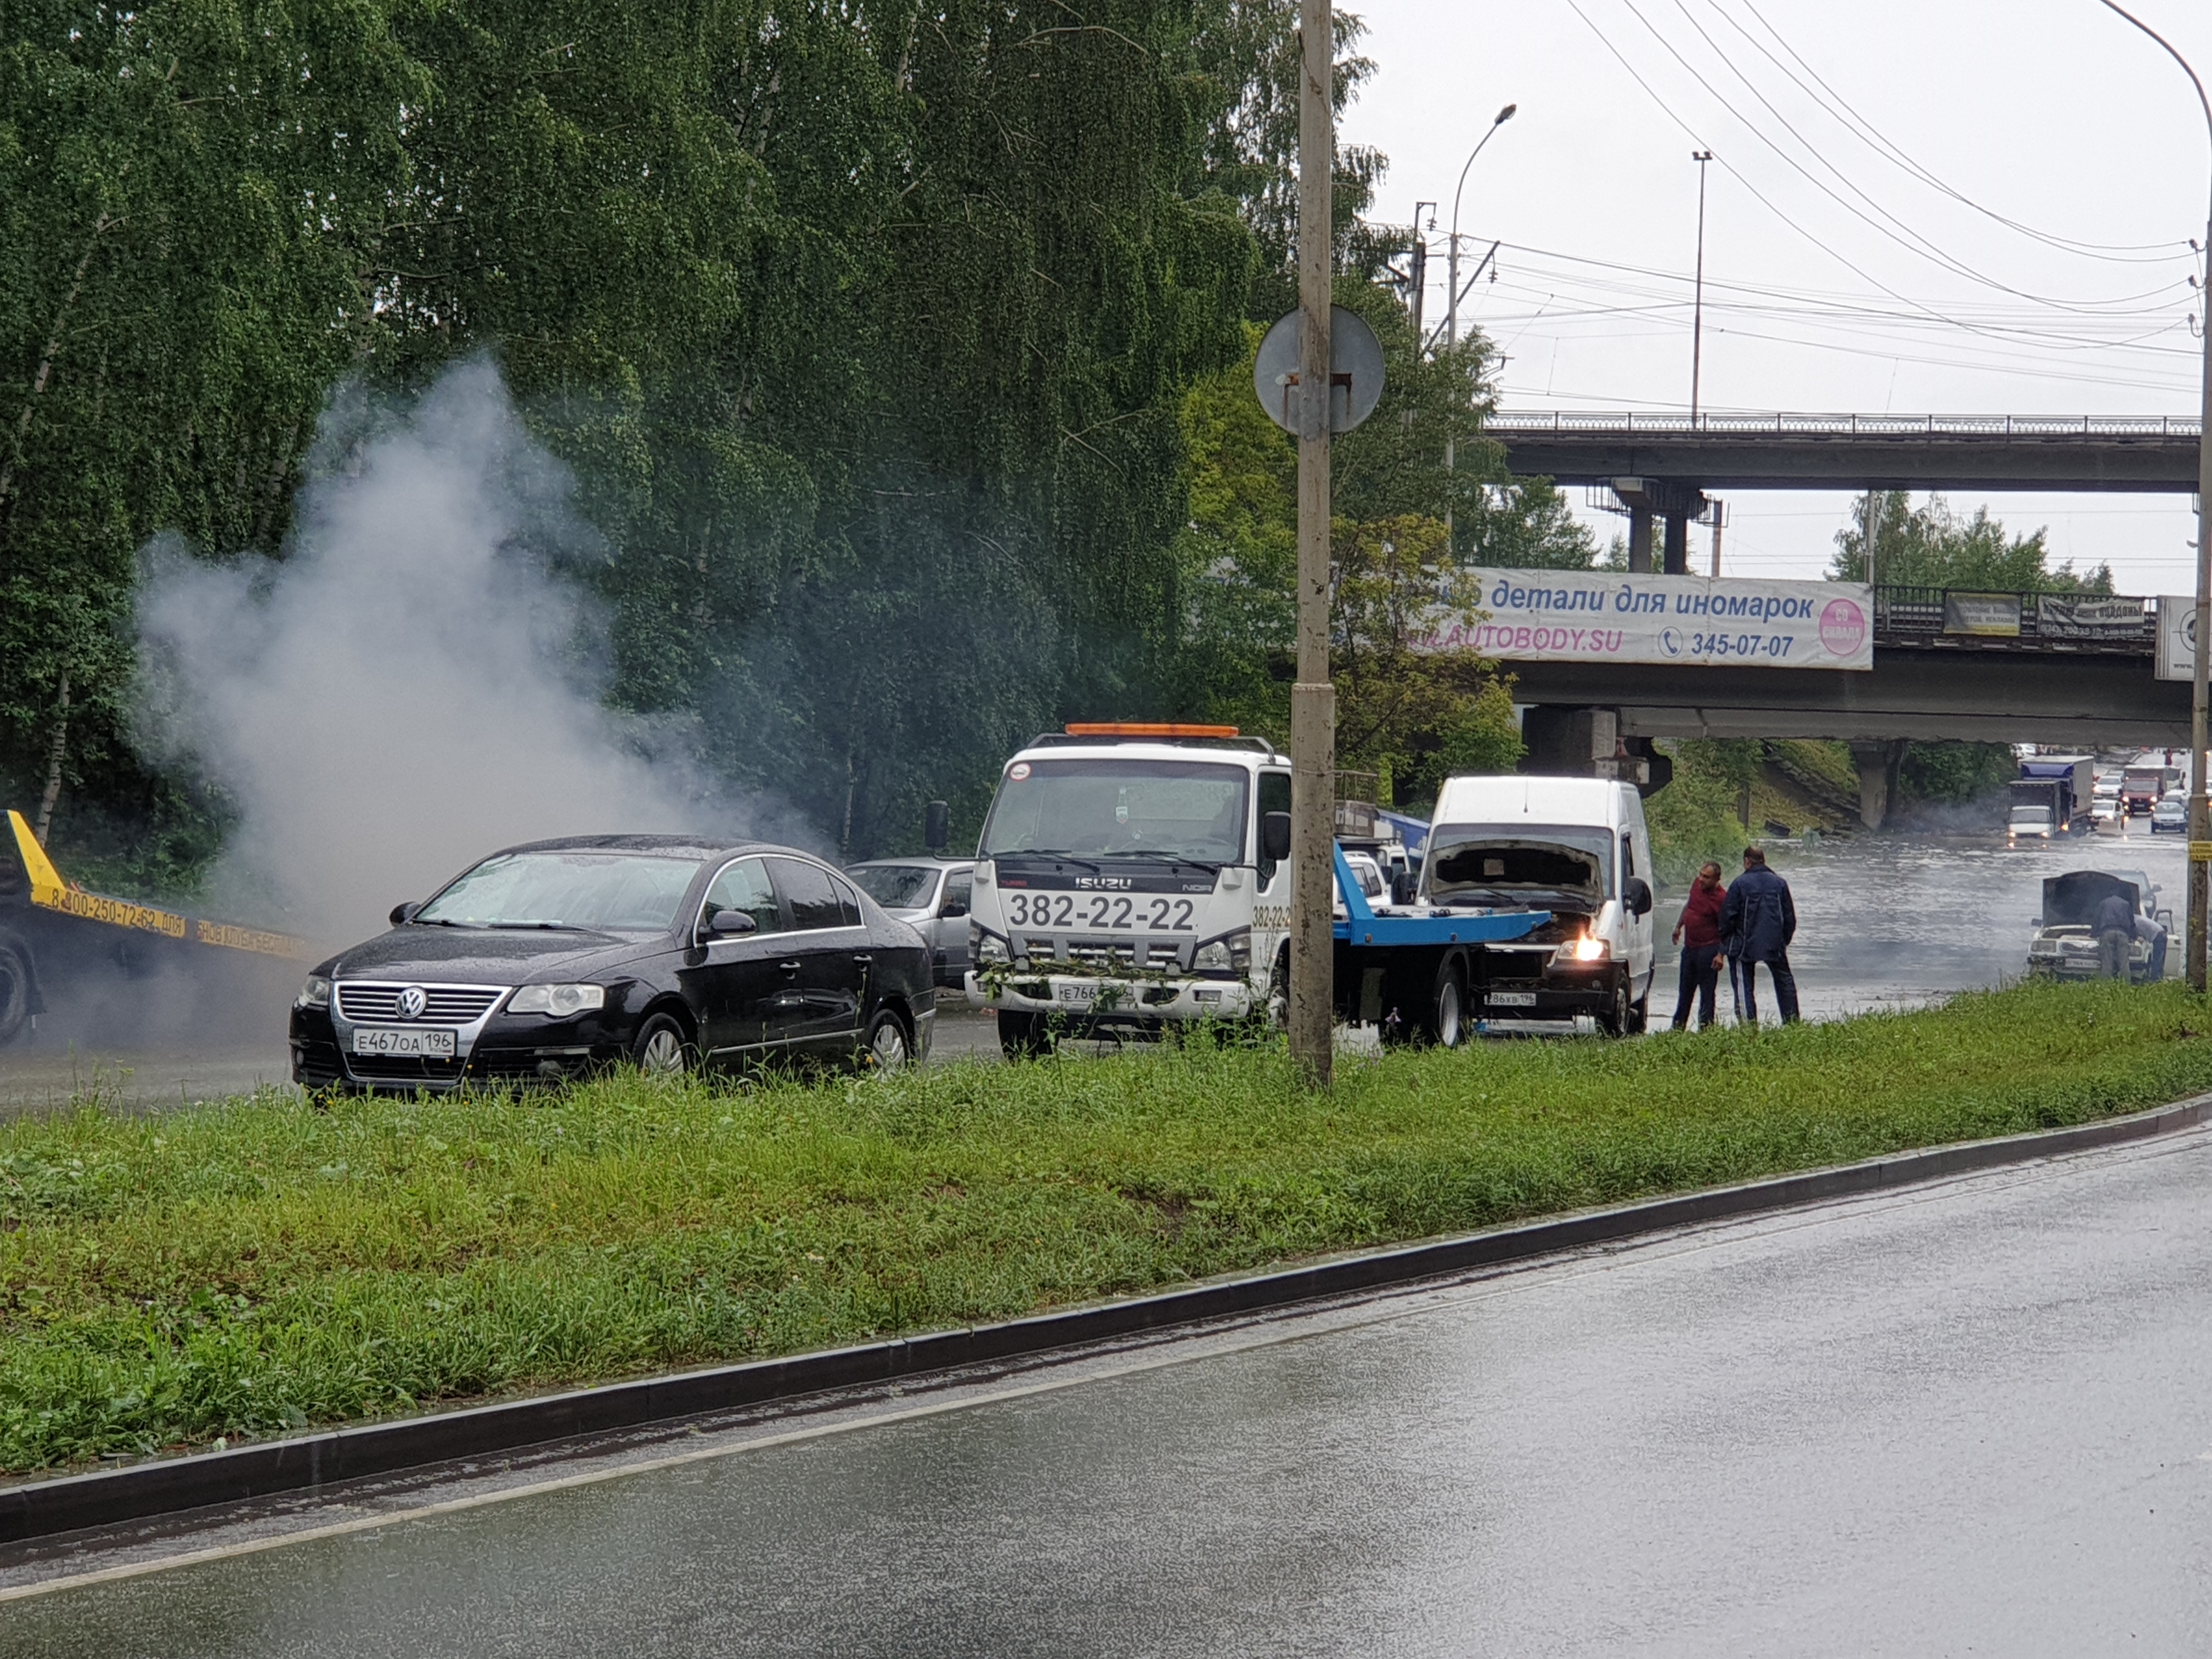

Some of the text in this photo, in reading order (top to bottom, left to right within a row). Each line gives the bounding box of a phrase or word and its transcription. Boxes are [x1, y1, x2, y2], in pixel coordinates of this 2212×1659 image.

[1491, 579, 1605, 611] детали
[1615, 584, 1666, 613] для
[1676, 593, 1814, 623] иномарок
[1691, 633, 1793, 657] 345-07-07
[1075, 877, 1132, 889] ISUZU
[1010, 894, 1193, 931] 382-22-22
[1252, 905, 1290, 928] 382-22-2
[425, 1034, 449, 1047] 196
